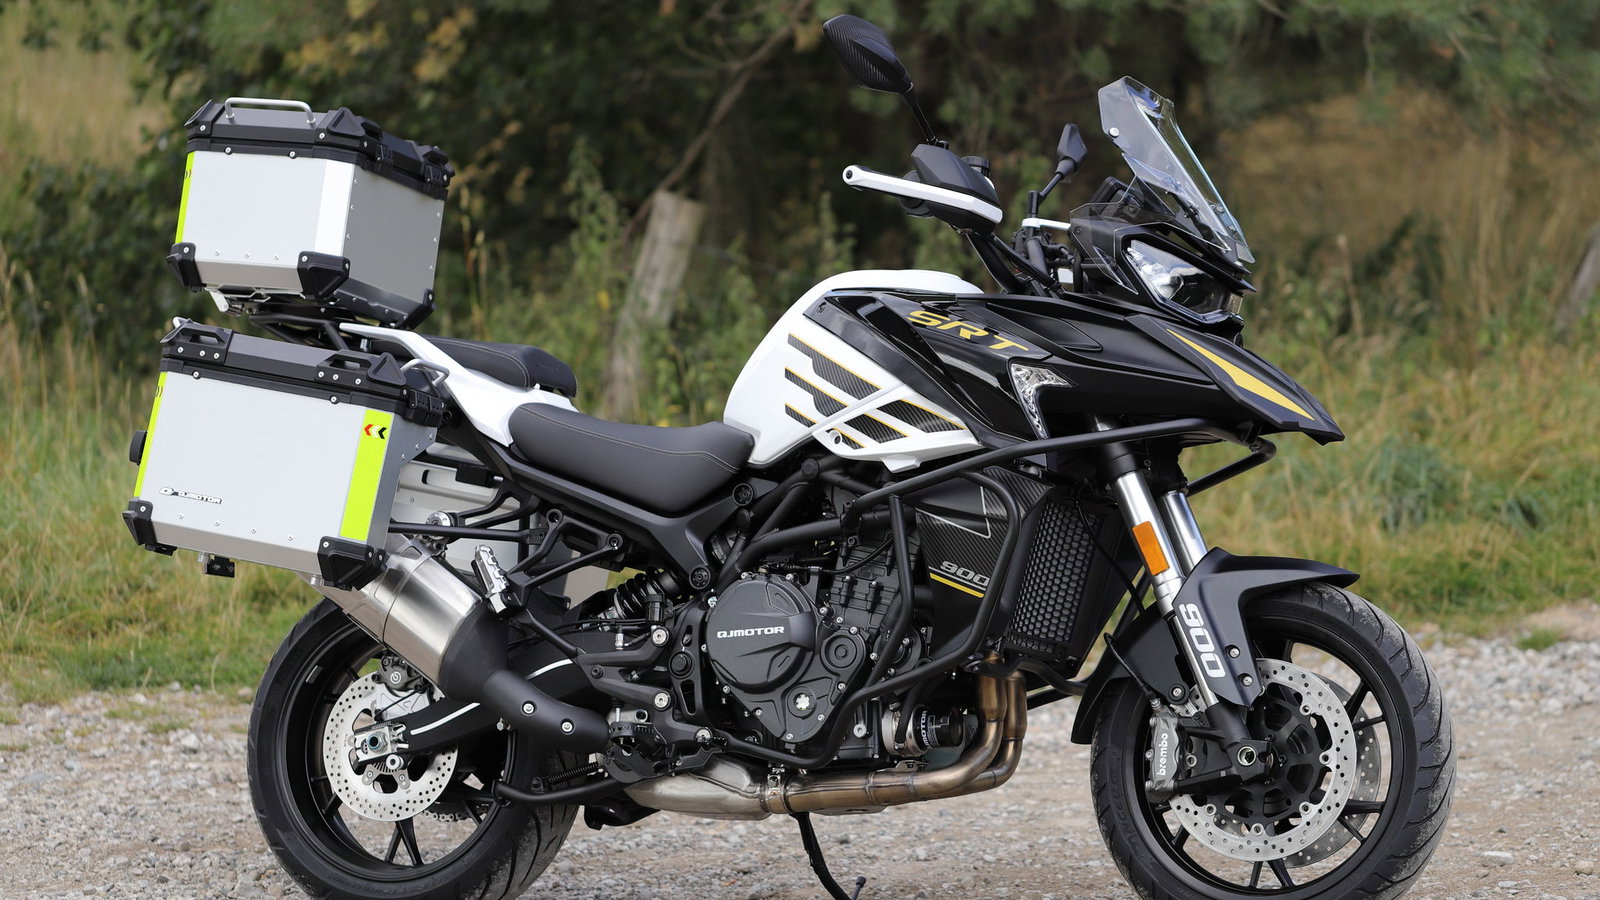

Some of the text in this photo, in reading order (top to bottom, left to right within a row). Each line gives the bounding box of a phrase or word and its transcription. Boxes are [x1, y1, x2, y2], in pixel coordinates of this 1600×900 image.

[907, 310, 1029, 351] SRT
[940, 561, 990, 587] 900
[716, 626, 785, 639] QJMOTOR
[1178, 603, 1226, 678] 900
[1157, 733, 1169, 776] brembo
